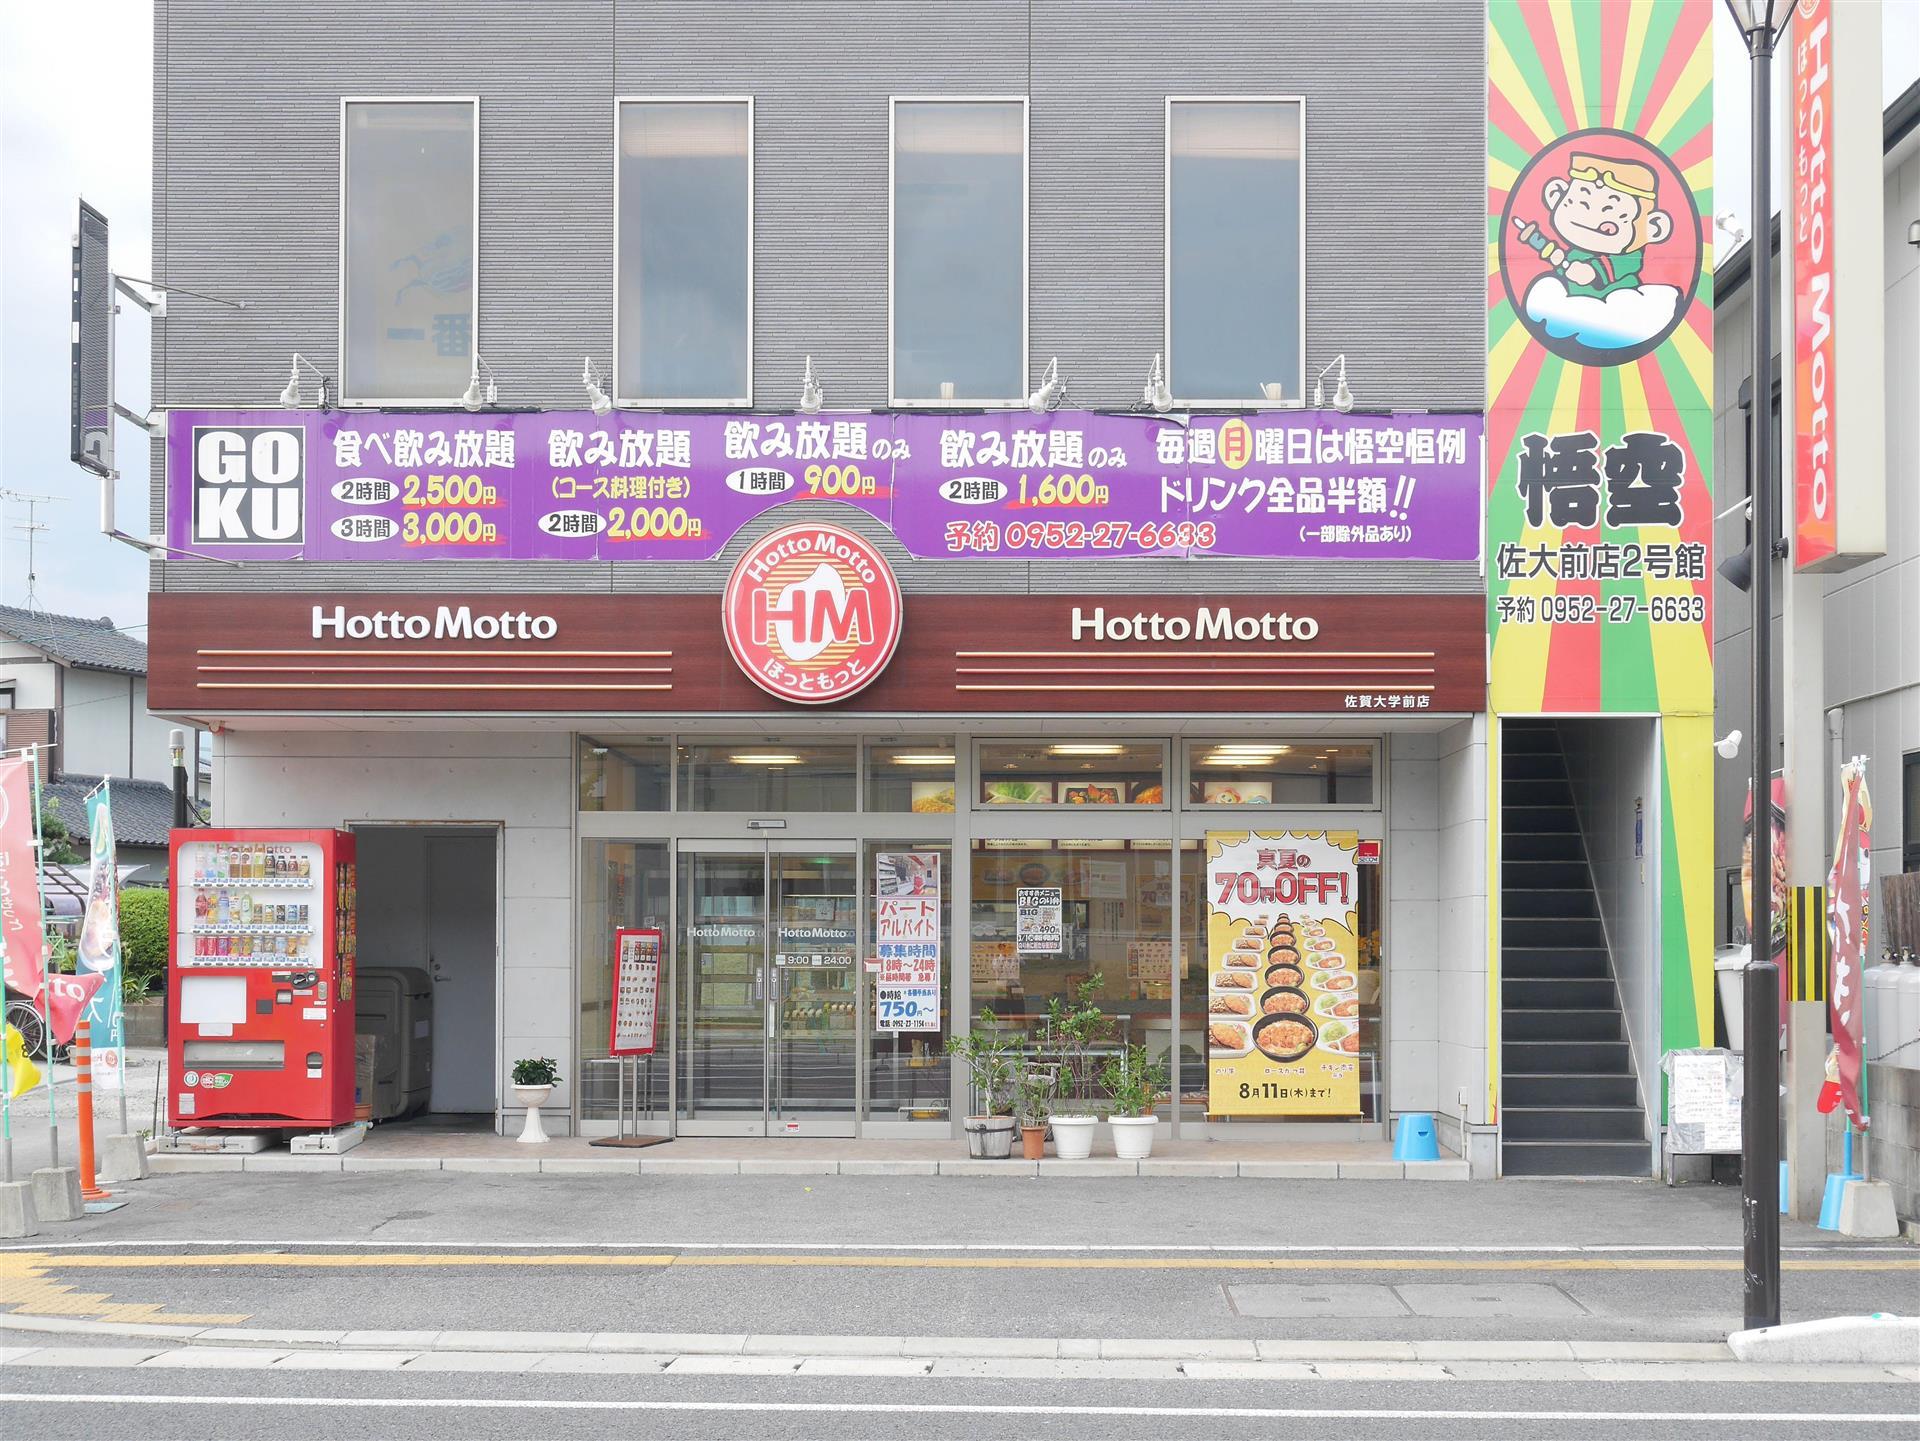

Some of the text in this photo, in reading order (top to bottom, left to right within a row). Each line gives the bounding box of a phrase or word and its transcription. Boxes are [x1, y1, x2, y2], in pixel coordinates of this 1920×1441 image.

[1797, 38, 1809, 244] ほっともっと
[332, 429, 515, 468] 食べ飲み放題
[548, 429, 691, 468] 飲み放題
[723, 421, 912, 460] 飲み放題のみ
[939, 429, 1127, 468] 飲み放題のみ
[1156, 427, 1466, 464] 毎週月曜日は悟空恒例
[198, 431, 299, 484] GO
[341, 475, 496, 507] 2時間 2,500円
[552, 475, 691, 499] (コース料理付き)
[738, 465, 876, 496] 1時間 900円
[949, 474, 1108, 507] 2時間 1,600円
[1517, 432, 1686, 528] 悟空
[198, 487, 299, 540] KU
[341, 512, 496, 544] 3時間 3,000円
[549, 507, 702, 540] 2時間 2,000円
[945, 521, 1216, 551] 予約 0952-27-6633
[1299, 525, 1412, 543] (一部除外品あり)
[1497, 543, 1705, 579] 佐大前店2号館
[752, 588, 874, 645] HM
[1497, 596, 1704, 623] 予約 0952-27-6633
[763, 657, 866, 691] ほっともっと
[1344, 694, 1430, 708] 佐賀大学前店
[1257, 848, 1311, 870] 真夏の
[881, 901, 935, 916] パート
[881, 919, 935, 936] アルバイト
[879, 945, 936, 958] 募集時間
[1239, 1083, 1332, 1099] 8月11日(木)まで!
